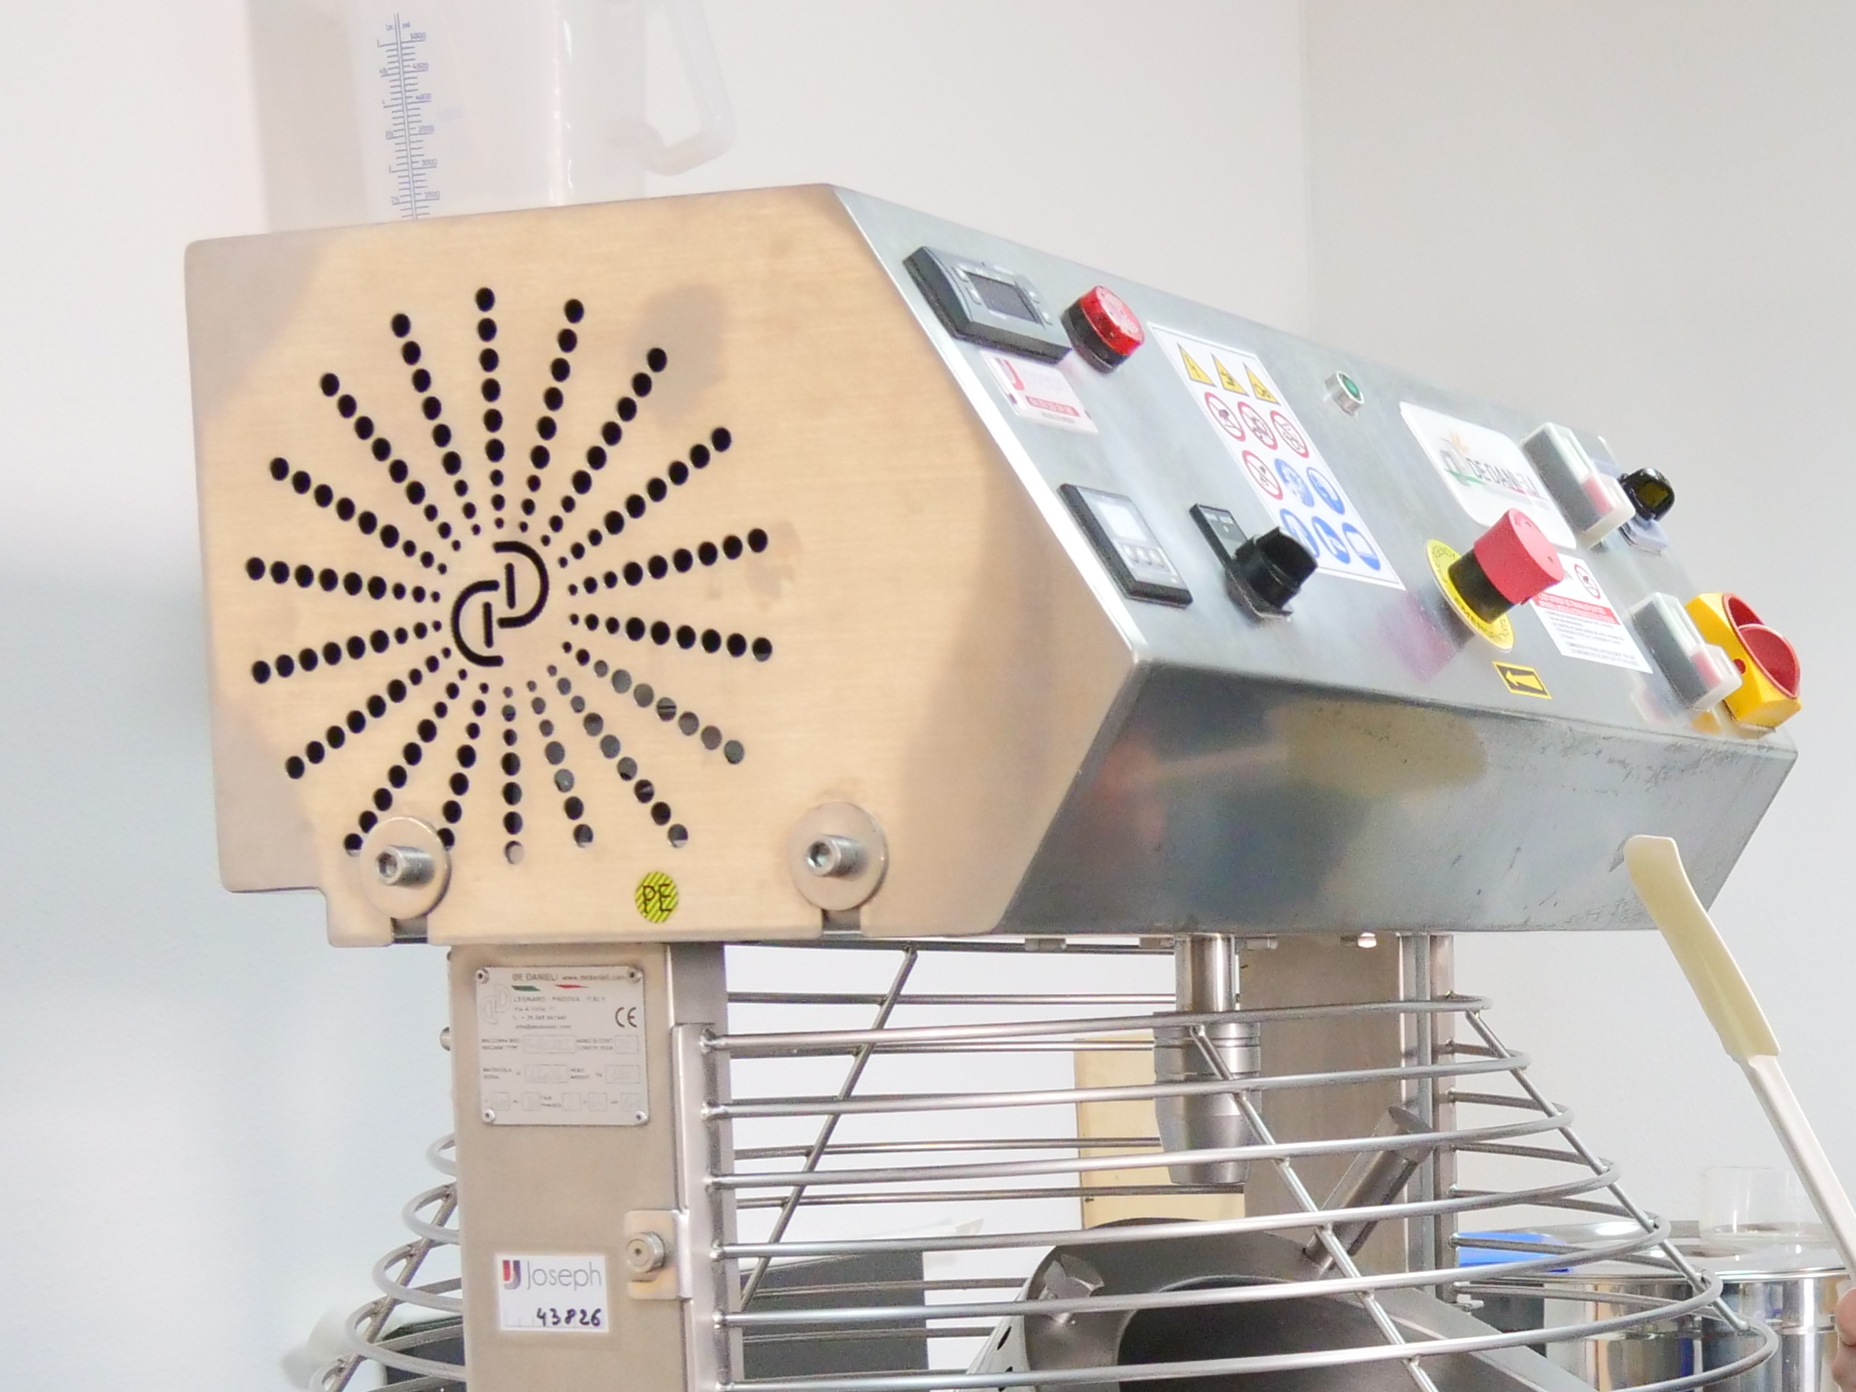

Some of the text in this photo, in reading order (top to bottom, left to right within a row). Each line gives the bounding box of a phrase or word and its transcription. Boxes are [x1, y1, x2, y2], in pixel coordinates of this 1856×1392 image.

[641, 883, 673, 914] PE
[615, 1006, 638, 1028] CE
[536, 1307, 602, 1328] 43826
